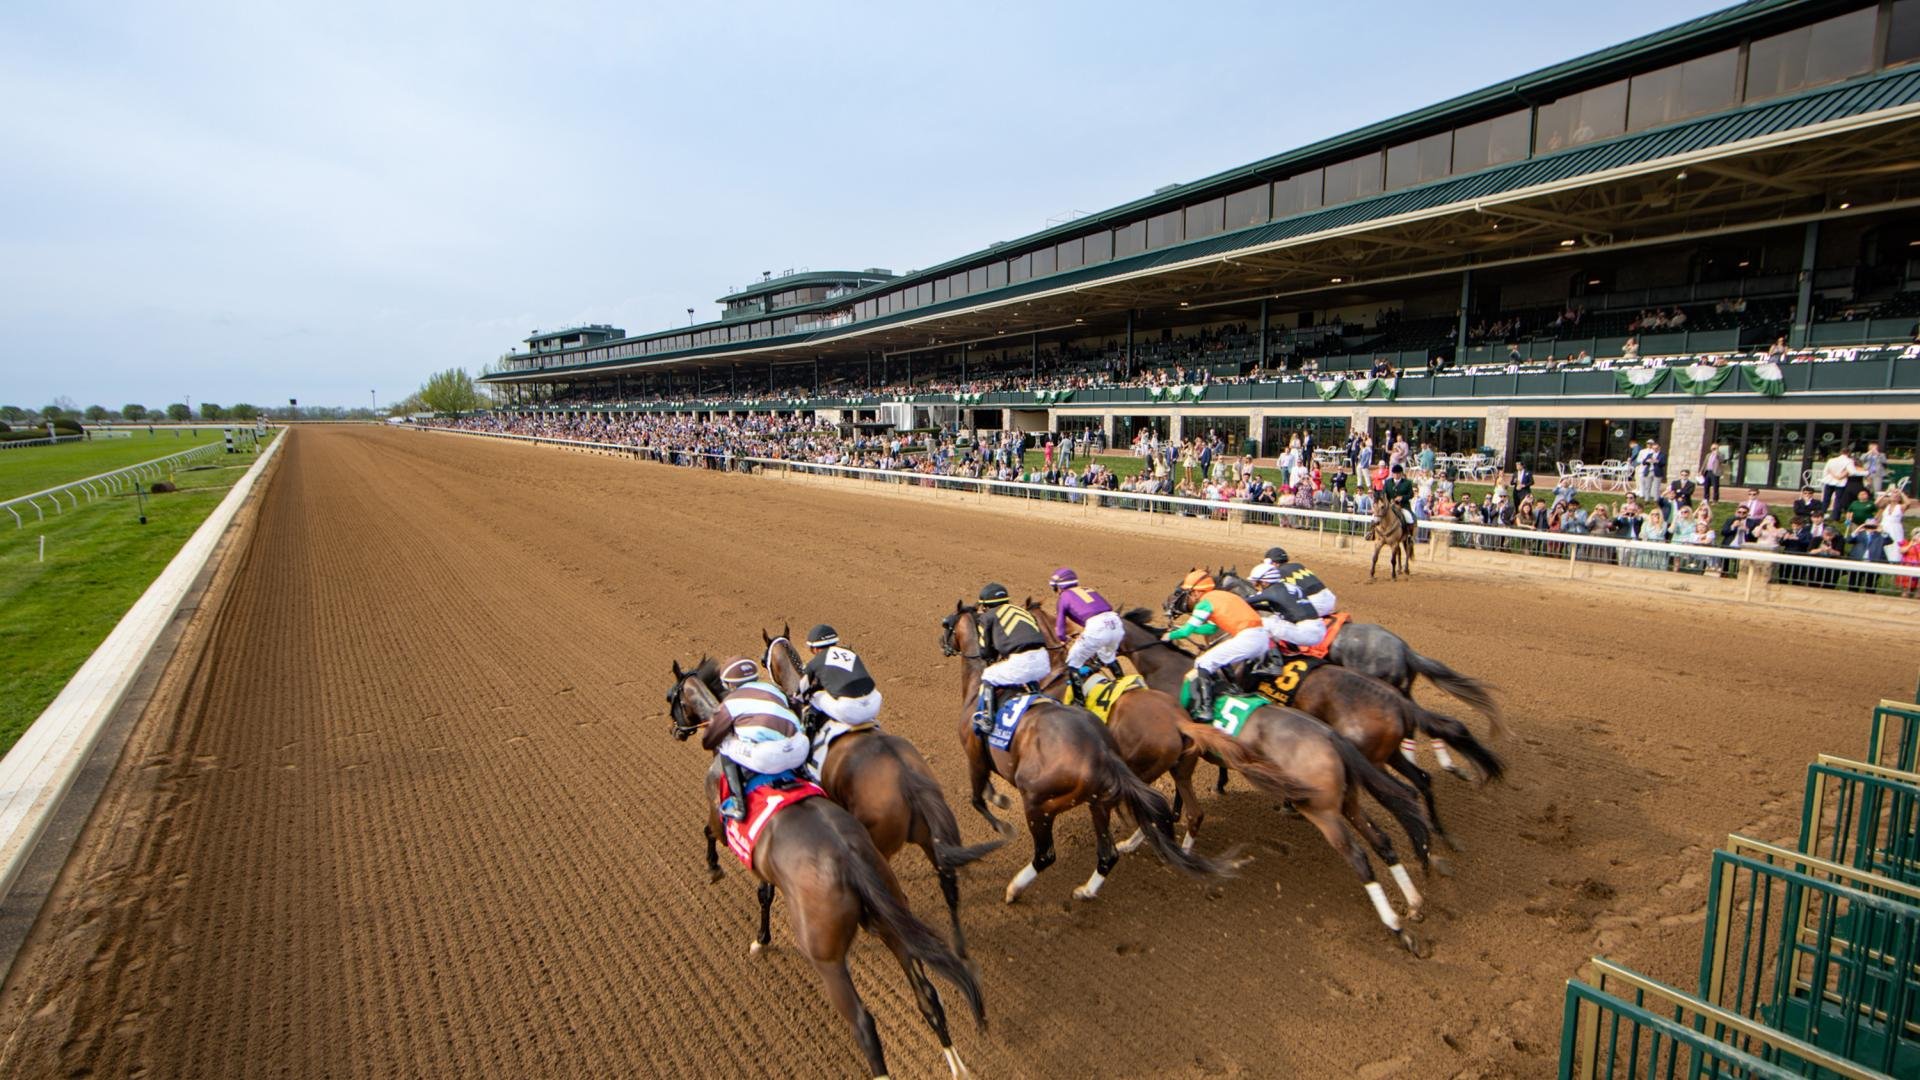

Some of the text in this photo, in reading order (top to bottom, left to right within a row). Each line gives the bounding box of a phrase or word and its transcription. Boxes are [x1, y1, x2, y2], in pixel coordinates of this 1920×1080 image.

[1274, 660, 1308, 691] 6
[1002, 694, 1030, 727] 3
[1096, 681, 1117, 712] 4
[1212, 696, 1250, 735] 5
[747, 795, 785, 841] 1
